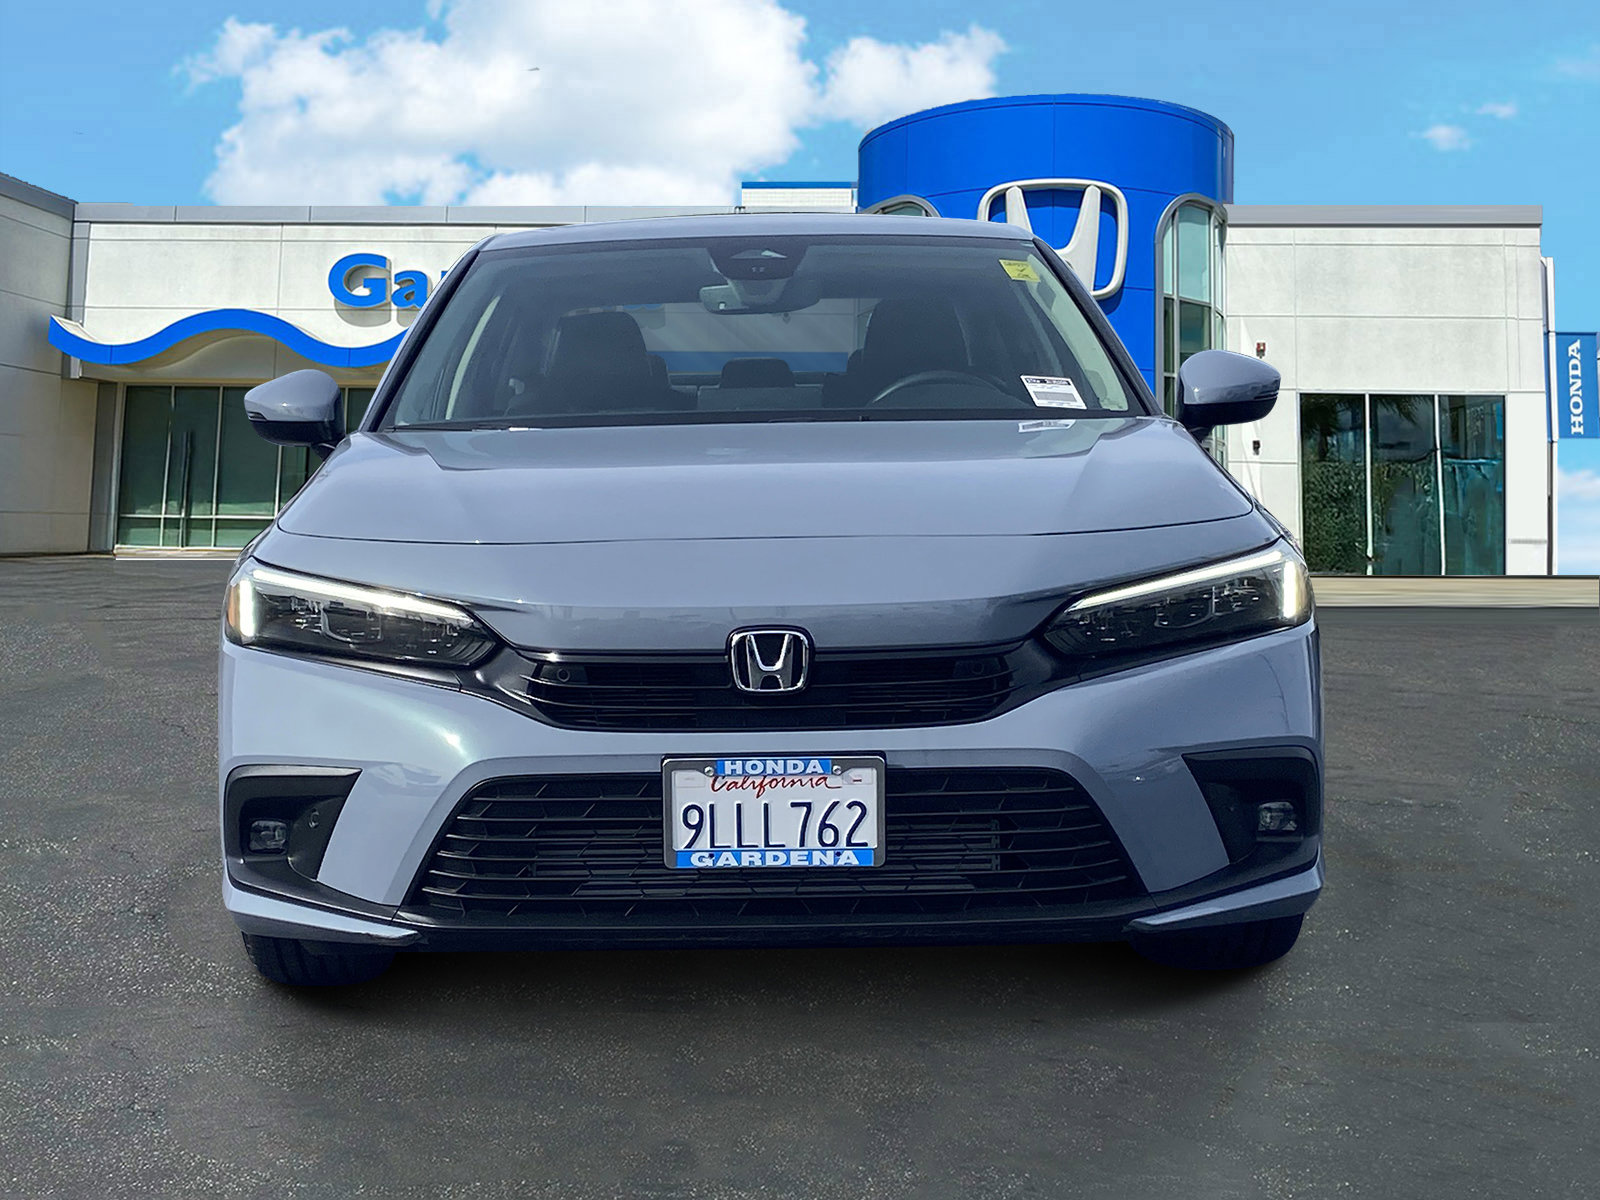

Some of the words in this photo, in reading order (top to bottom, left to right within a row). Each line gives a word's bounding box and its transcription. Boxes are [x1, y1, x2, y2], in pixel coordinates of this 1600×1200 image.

[328, 252, 449, 308] Ga
[1568, 339, 1584, 435] HONDA
[724, 760, 825, 775] HONDA
[711, 774, 842, 799] California
[682, 800, 869, 849] 9LLL762
[690, 851, 860, 867] GARDENA
